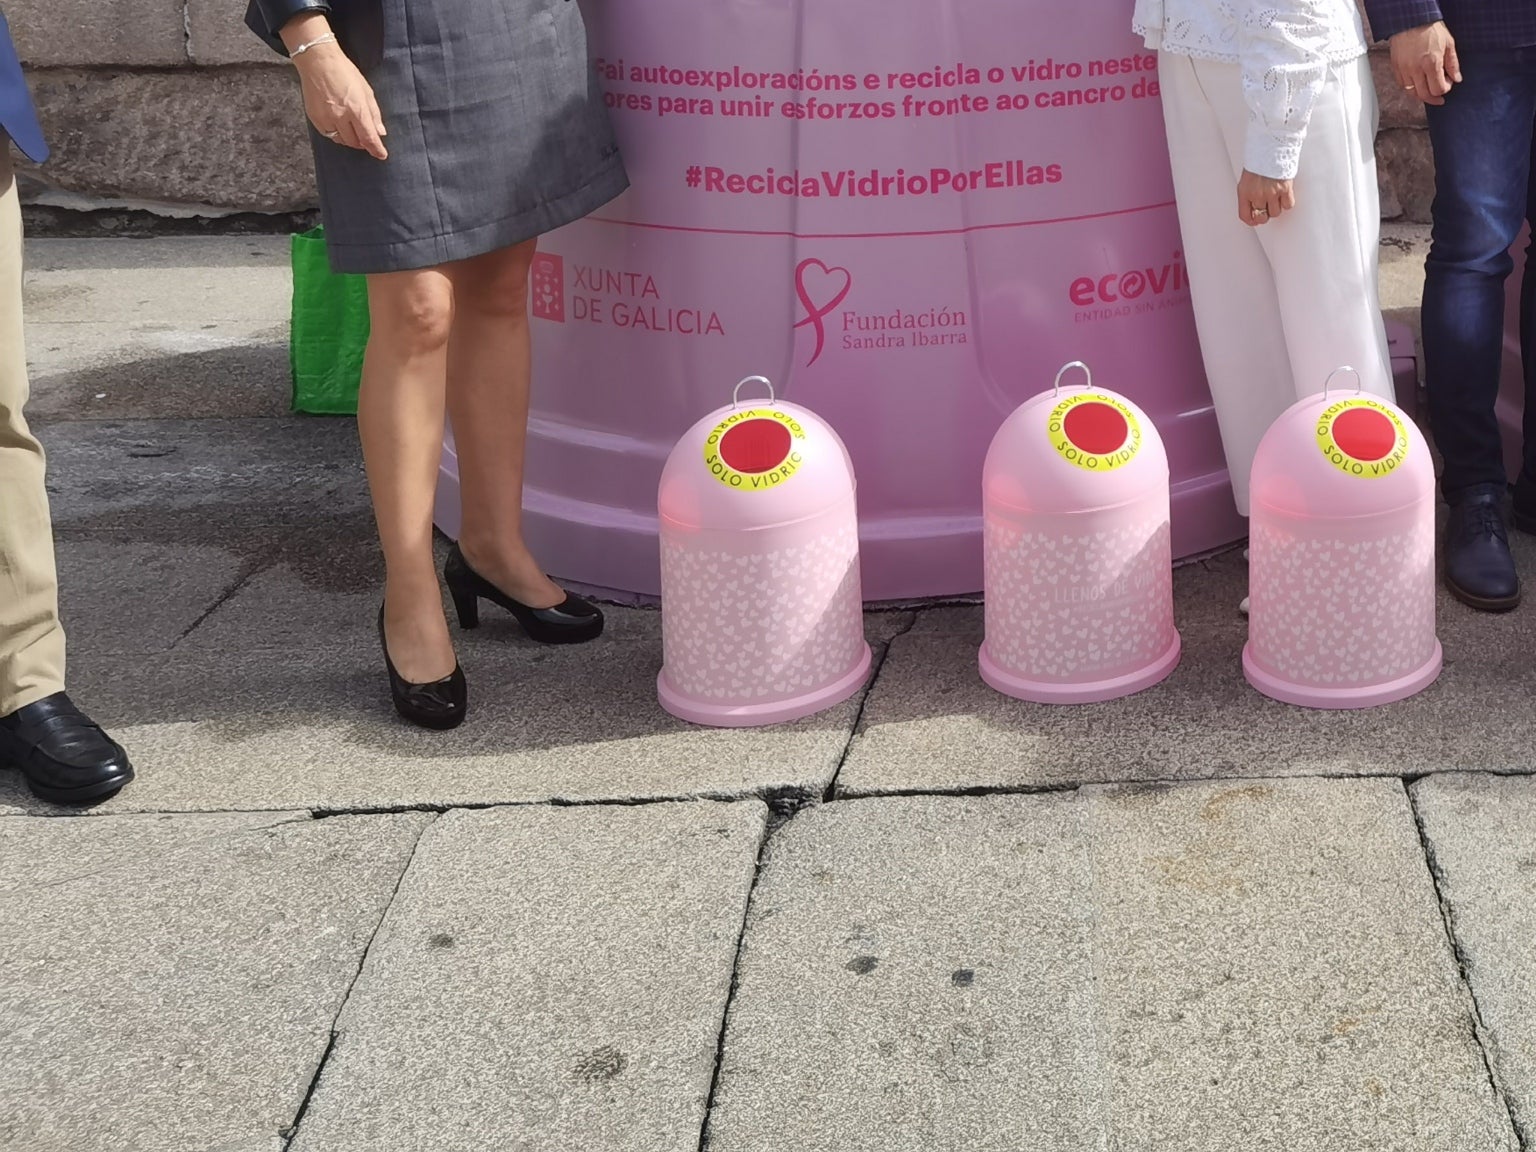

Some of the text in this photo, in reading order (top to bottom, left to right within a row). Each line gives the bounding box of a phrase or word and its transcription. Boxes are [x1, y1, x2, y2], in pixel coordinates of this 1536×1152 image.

[630, 65, 857, 92] autoexploracións
[863, 73, 881, 90] e
[887, 62, 981, 90] recicla
[987, 66, 1004, 84] o
[1011, 58, 1082, 82] vidro
[658, 95, 714, 116] para
[720, 94, 774, 118] unir
[781, 97, 896, 121] esforzos
[902, 94, 989, 117] fronte
[996, 95, 1030, 111] ao
[1034, 84, 1126, 109] cancro
[1131, 76, 1161, 99] de
[685, 159, 1063, 198] #ReciclaVidrioPorEllas
[573, 264, 660, 299] XUNTA
[573, 295, 725, 336] DE GALICIA
[842, 306, 966, 331] Fundación
[1074, 306, 1131, 323] ENTIDAD
[842, 331, 967, 349] Sandra Ibarra
[707, 411, 755, 445] VIDRIO
[706, 454, 742, 486] SOLO
[1057, 441, 1098, 468] SOLO
[1324, 437, 1407, 475] SOLO VIDRIO
